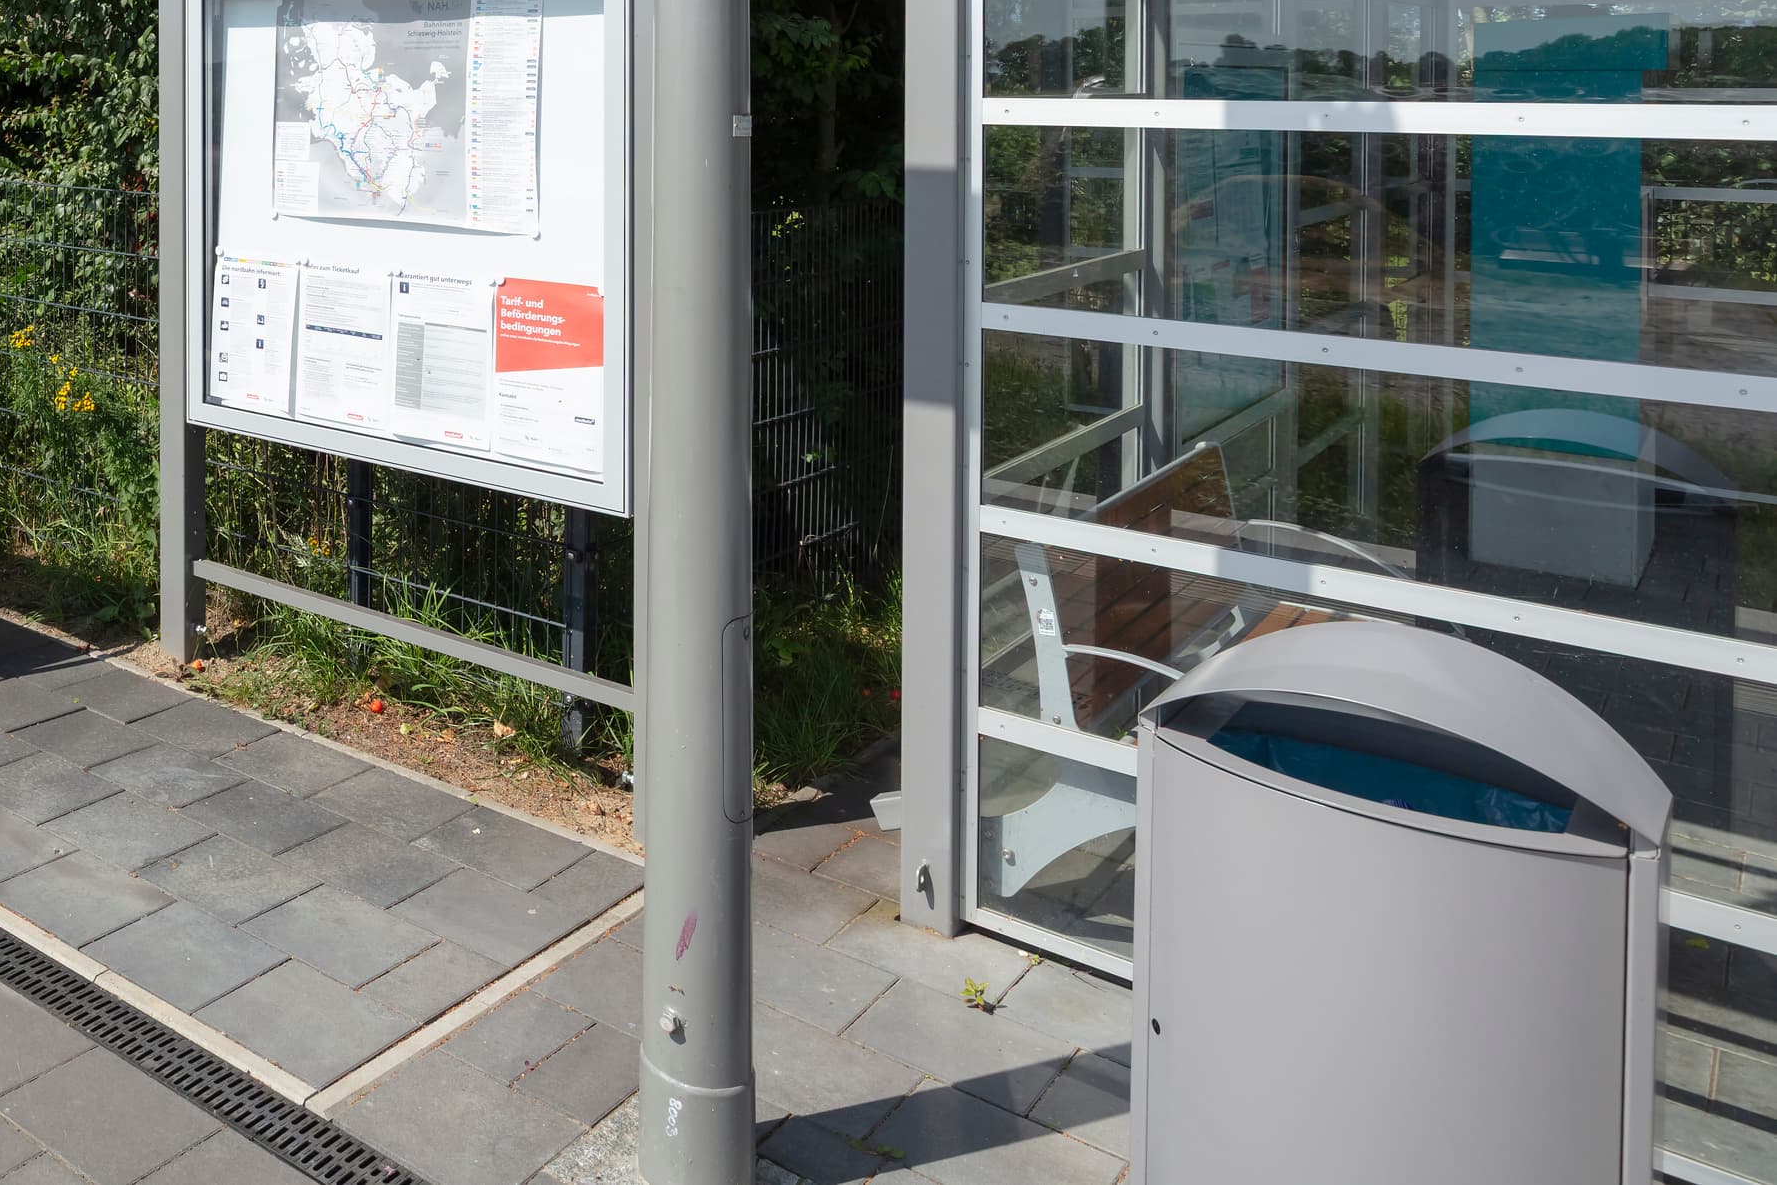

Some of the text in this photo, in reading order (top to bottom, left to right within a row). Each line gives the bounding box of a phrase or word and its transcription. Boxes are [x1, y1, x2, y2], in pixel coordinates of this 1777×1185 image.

[500, 295, 544, 309] Tarif- und
[500, 308, 566, 325] Beförderungs-
[500, 319, 562, 337] bedingungen
